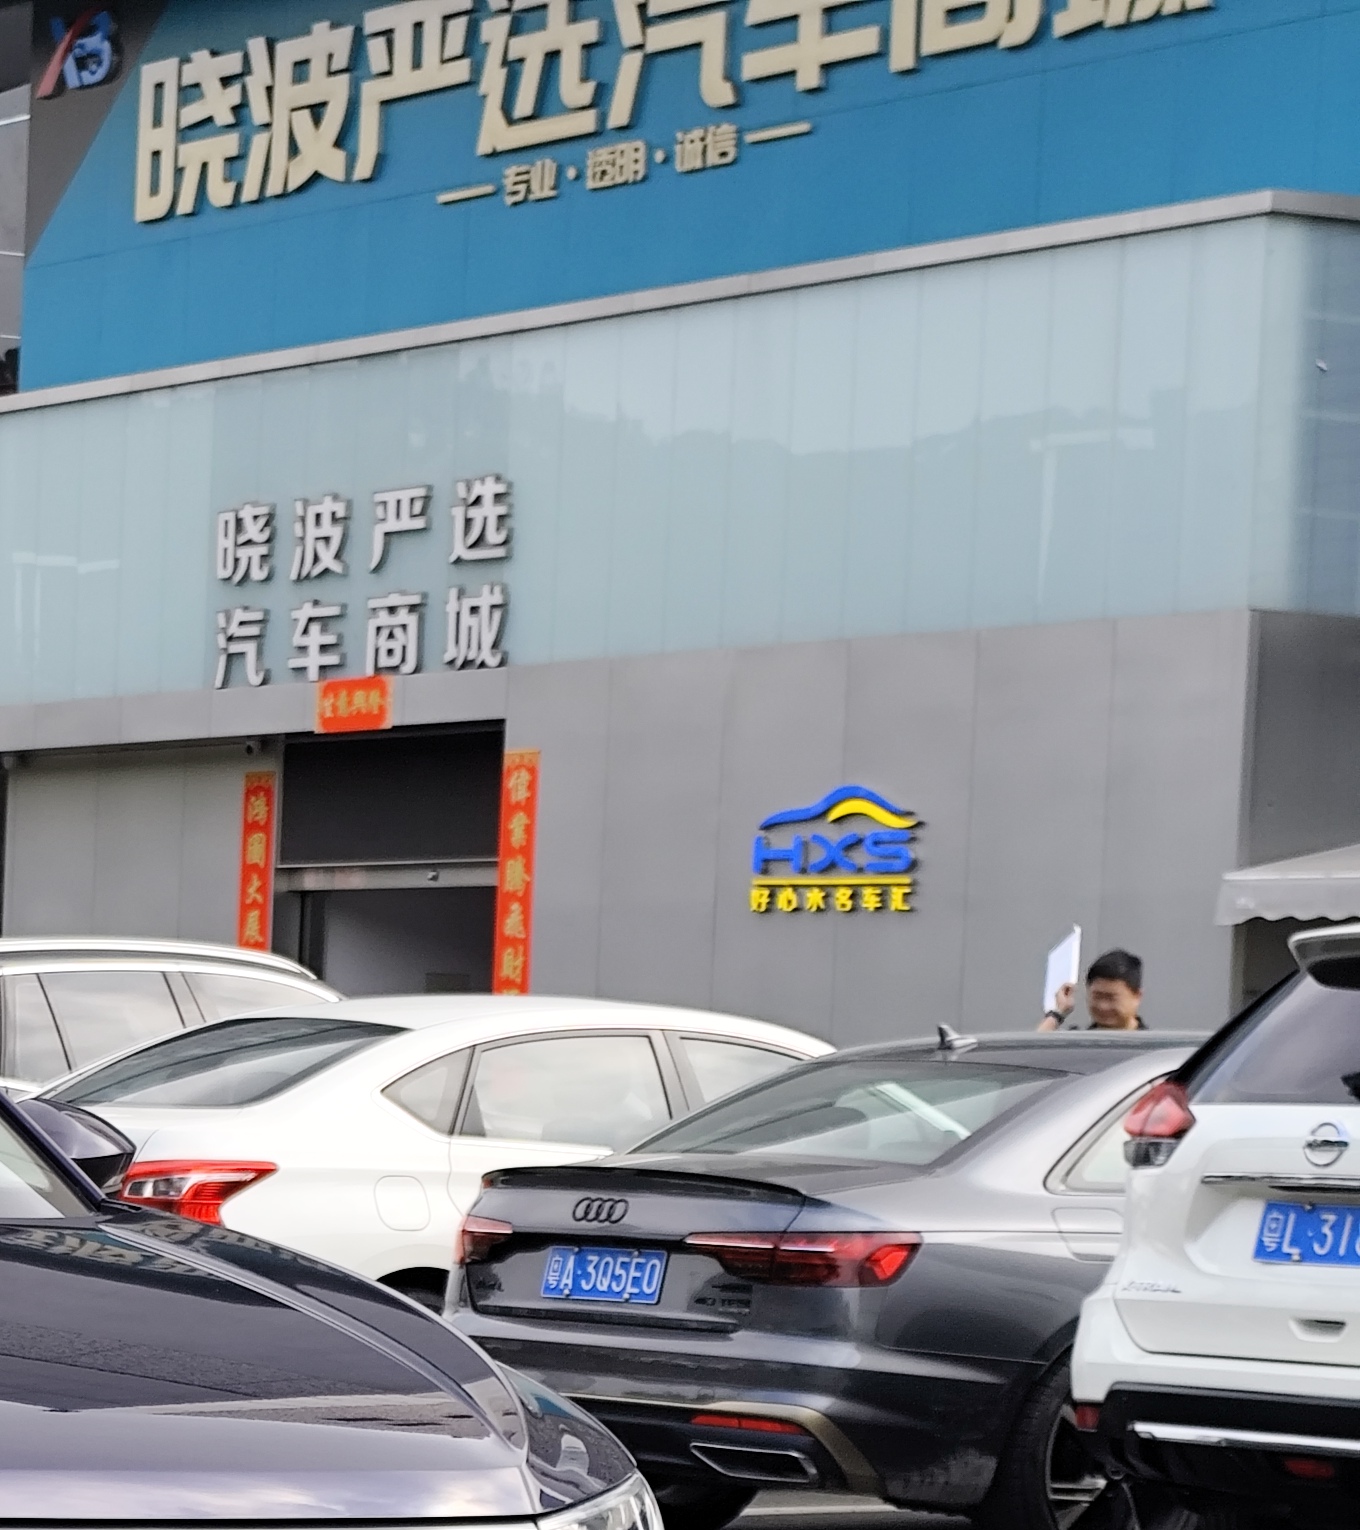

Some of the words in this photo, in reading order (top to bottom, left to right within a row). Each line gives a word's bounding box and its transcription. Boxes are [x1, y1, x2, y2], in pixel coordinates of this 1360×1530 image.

[134, 0, 1215, 223] 晓波严选汽车
[216, 473, 509, 584] 晓波严选
[214, 582, 505, 689] 汽车商城
[749, 886, 913, 914] 好心水名车汇
[752, 830, 914, 874] HXS
